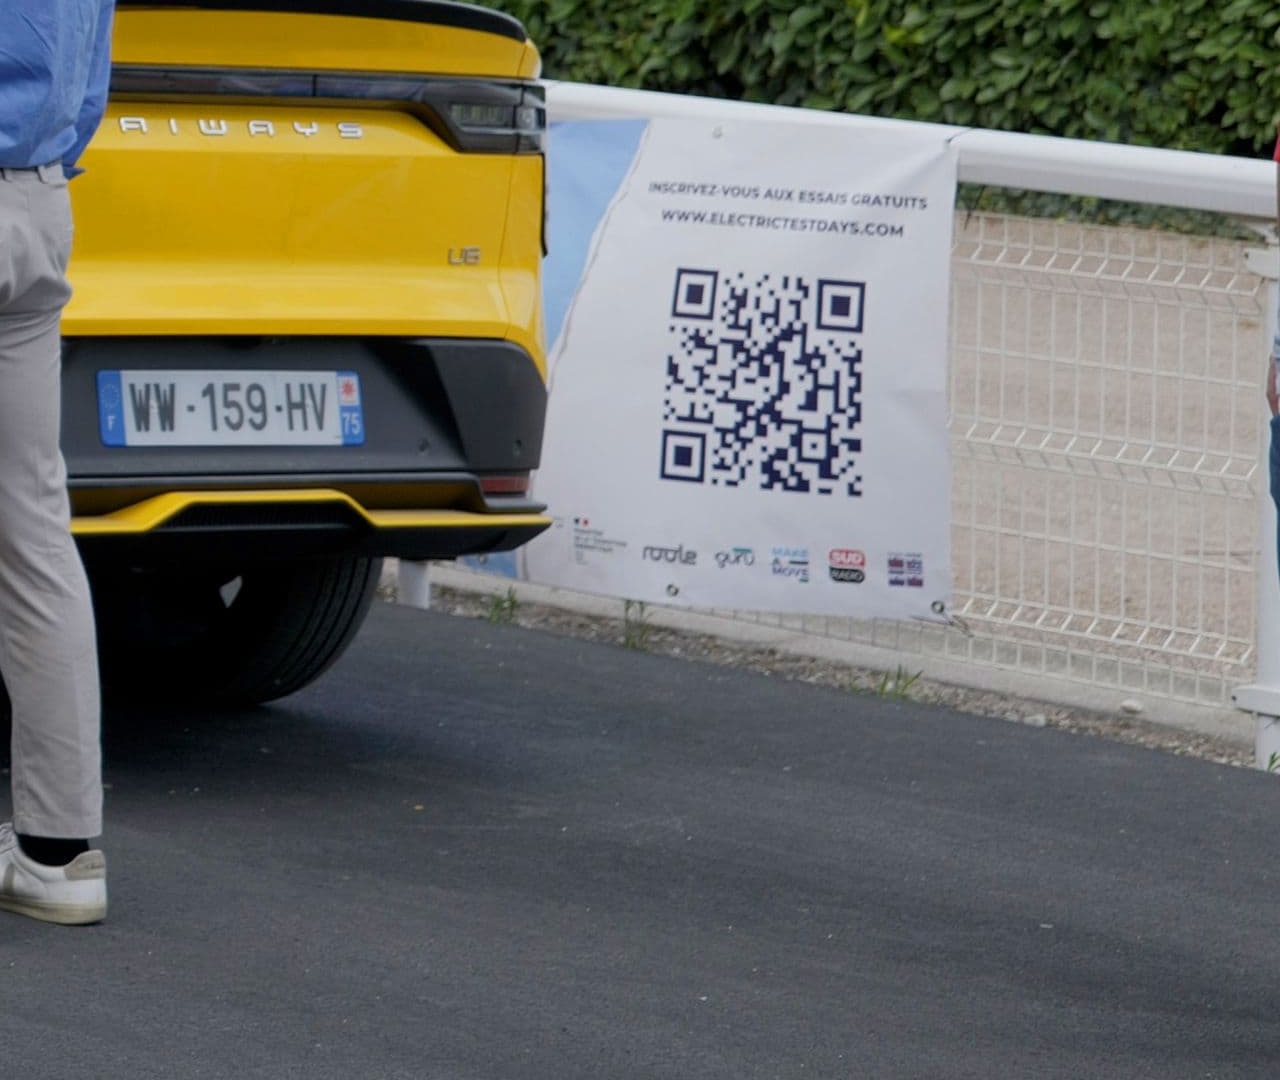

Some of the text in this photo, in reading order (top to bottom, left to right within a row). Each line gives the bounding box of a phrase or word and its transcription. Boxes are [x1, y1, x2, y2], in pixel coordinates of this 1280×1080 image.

[118, 116, 363, 139] AIWAYS
[648, 181, 928, 210] INSCRIVEZ-VOUS AUX ESSAIS GRATUITS
[661, 209, 905, 238] WWW.ELECTRICTESTDAYS.COM
[448, 246, 481, 265] U6
[107, 416, 115, 431] F
[342, 412, 361, 435] 75
[831, 550, 864, 566] SUD
